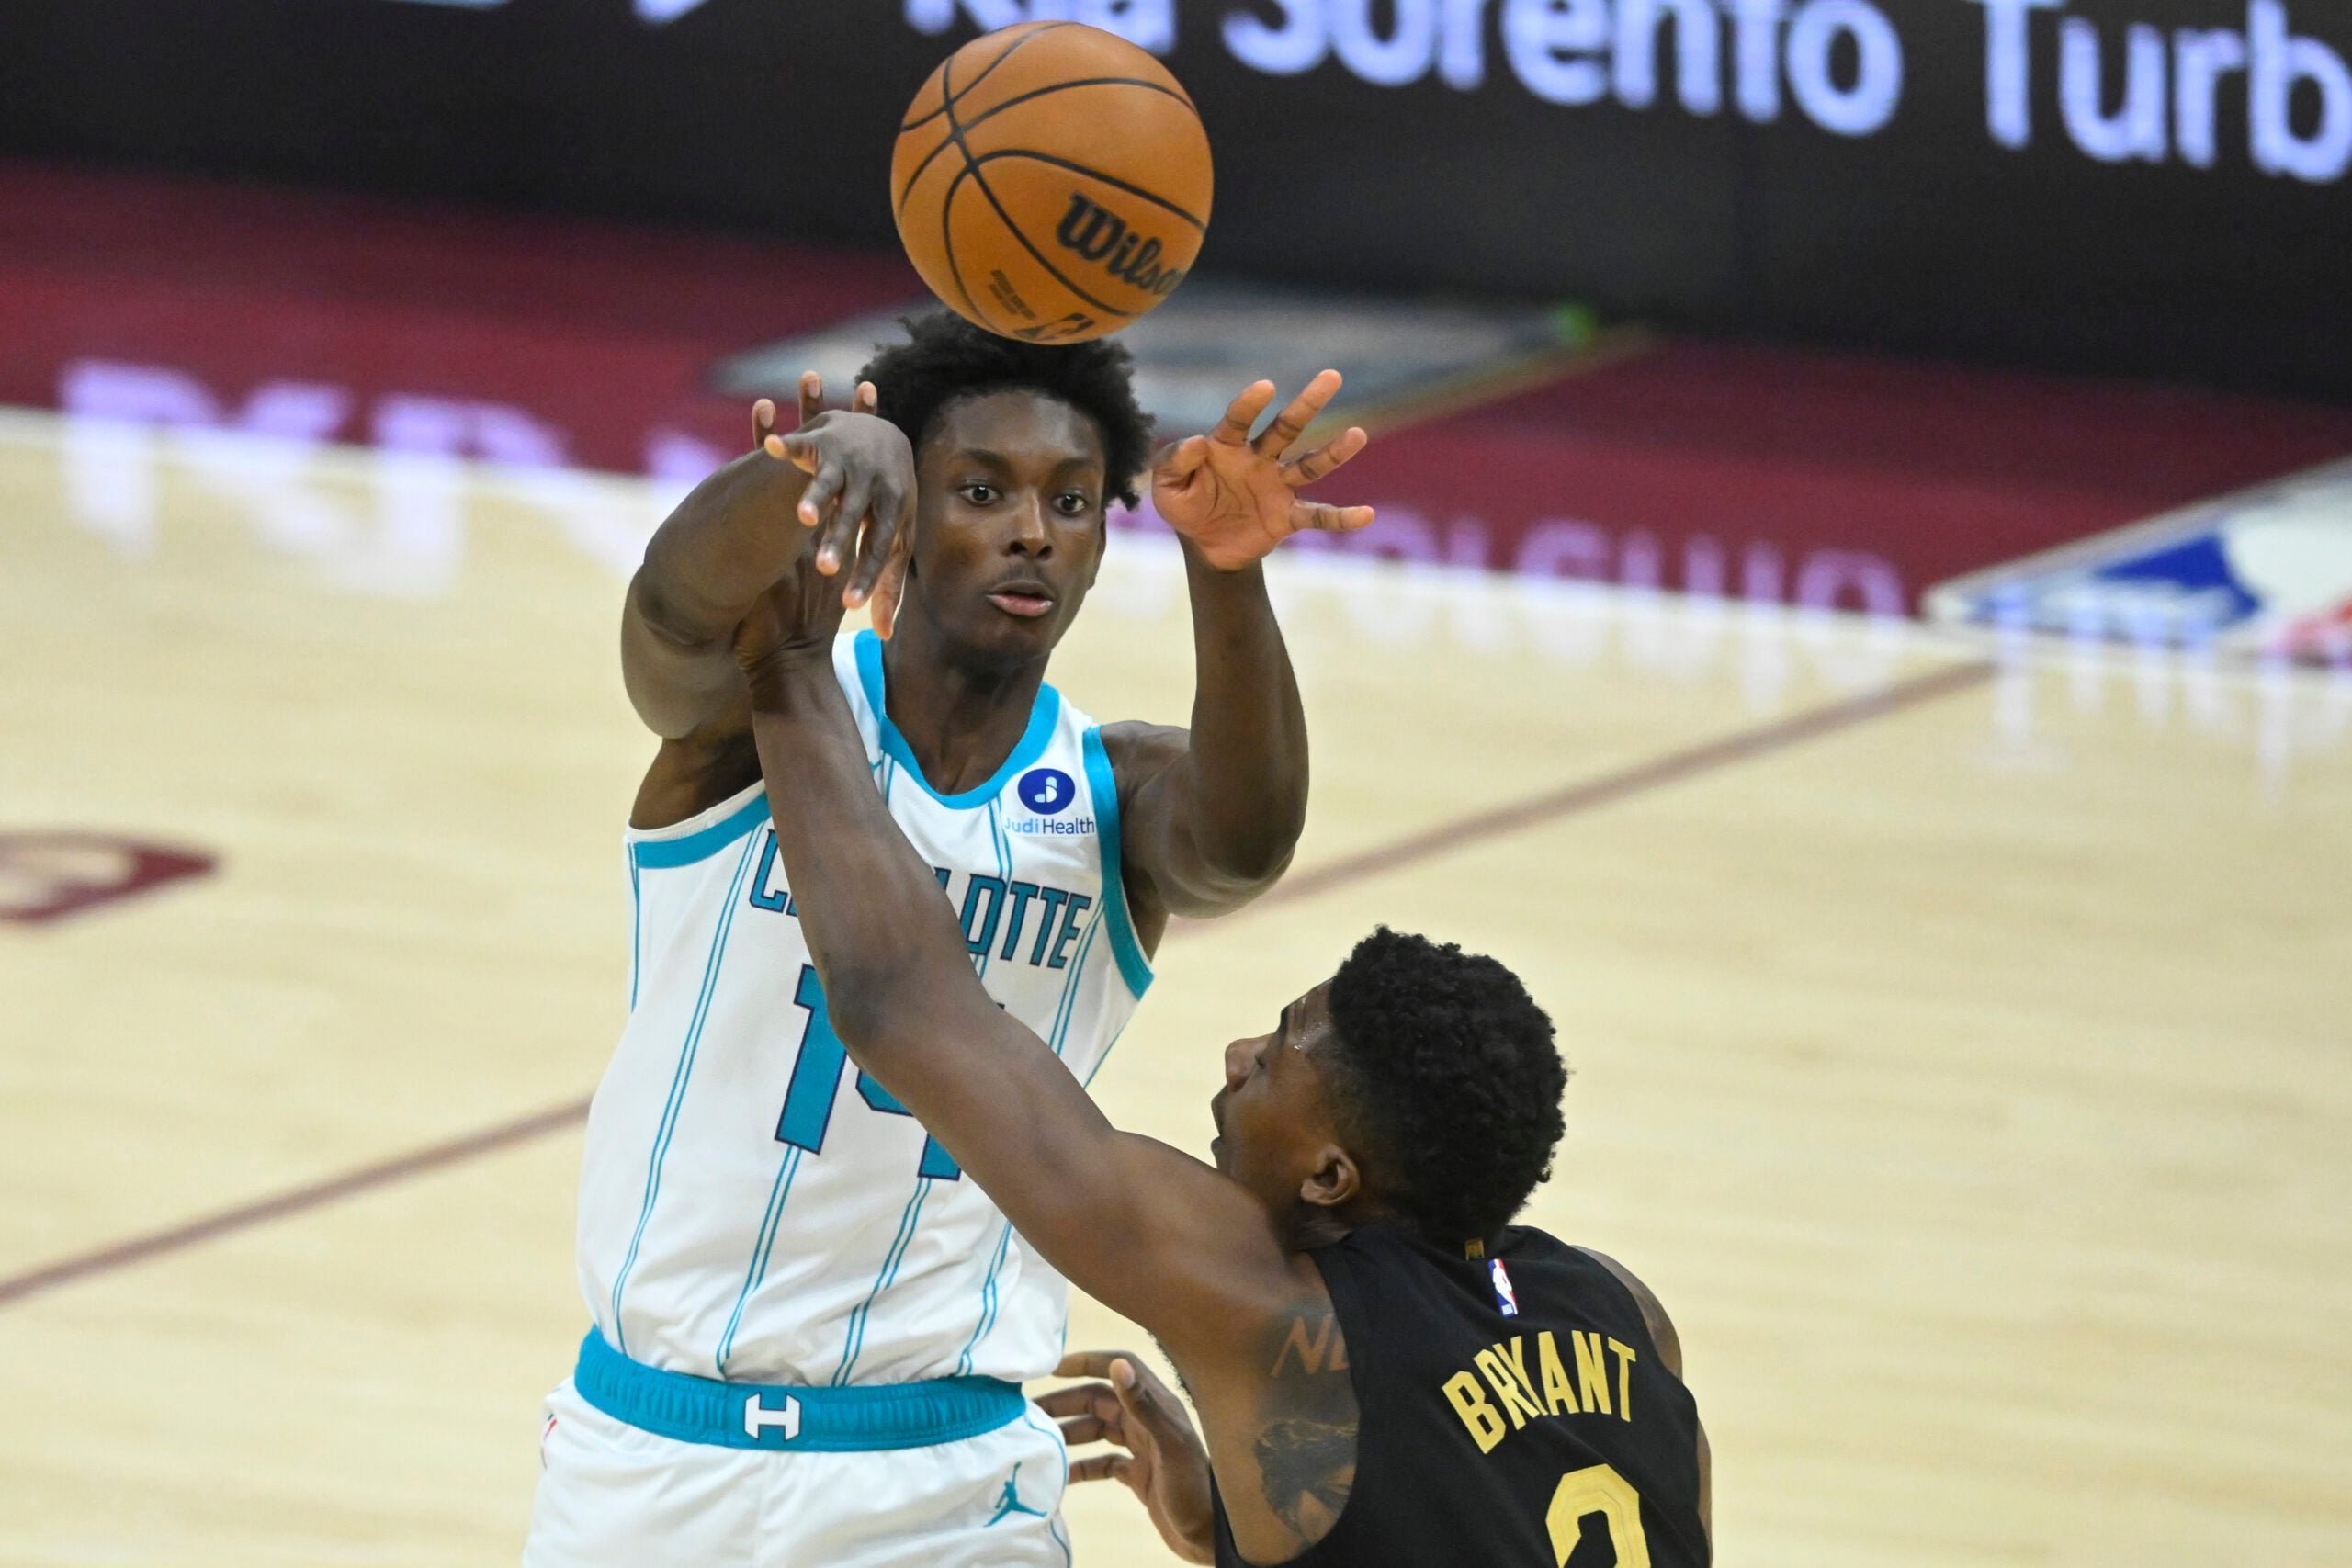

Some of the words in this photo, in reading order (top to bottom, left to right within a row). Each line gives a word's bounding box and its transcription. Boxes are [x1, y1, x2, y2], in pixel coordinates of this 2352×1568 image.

[1004, 817, 1039, 834] Judi
[1042, 817, 1095, 835] Health
[749, 829, 1092, 970] COTTE
[1441, 1329, 1636, 1454] BRYANT
